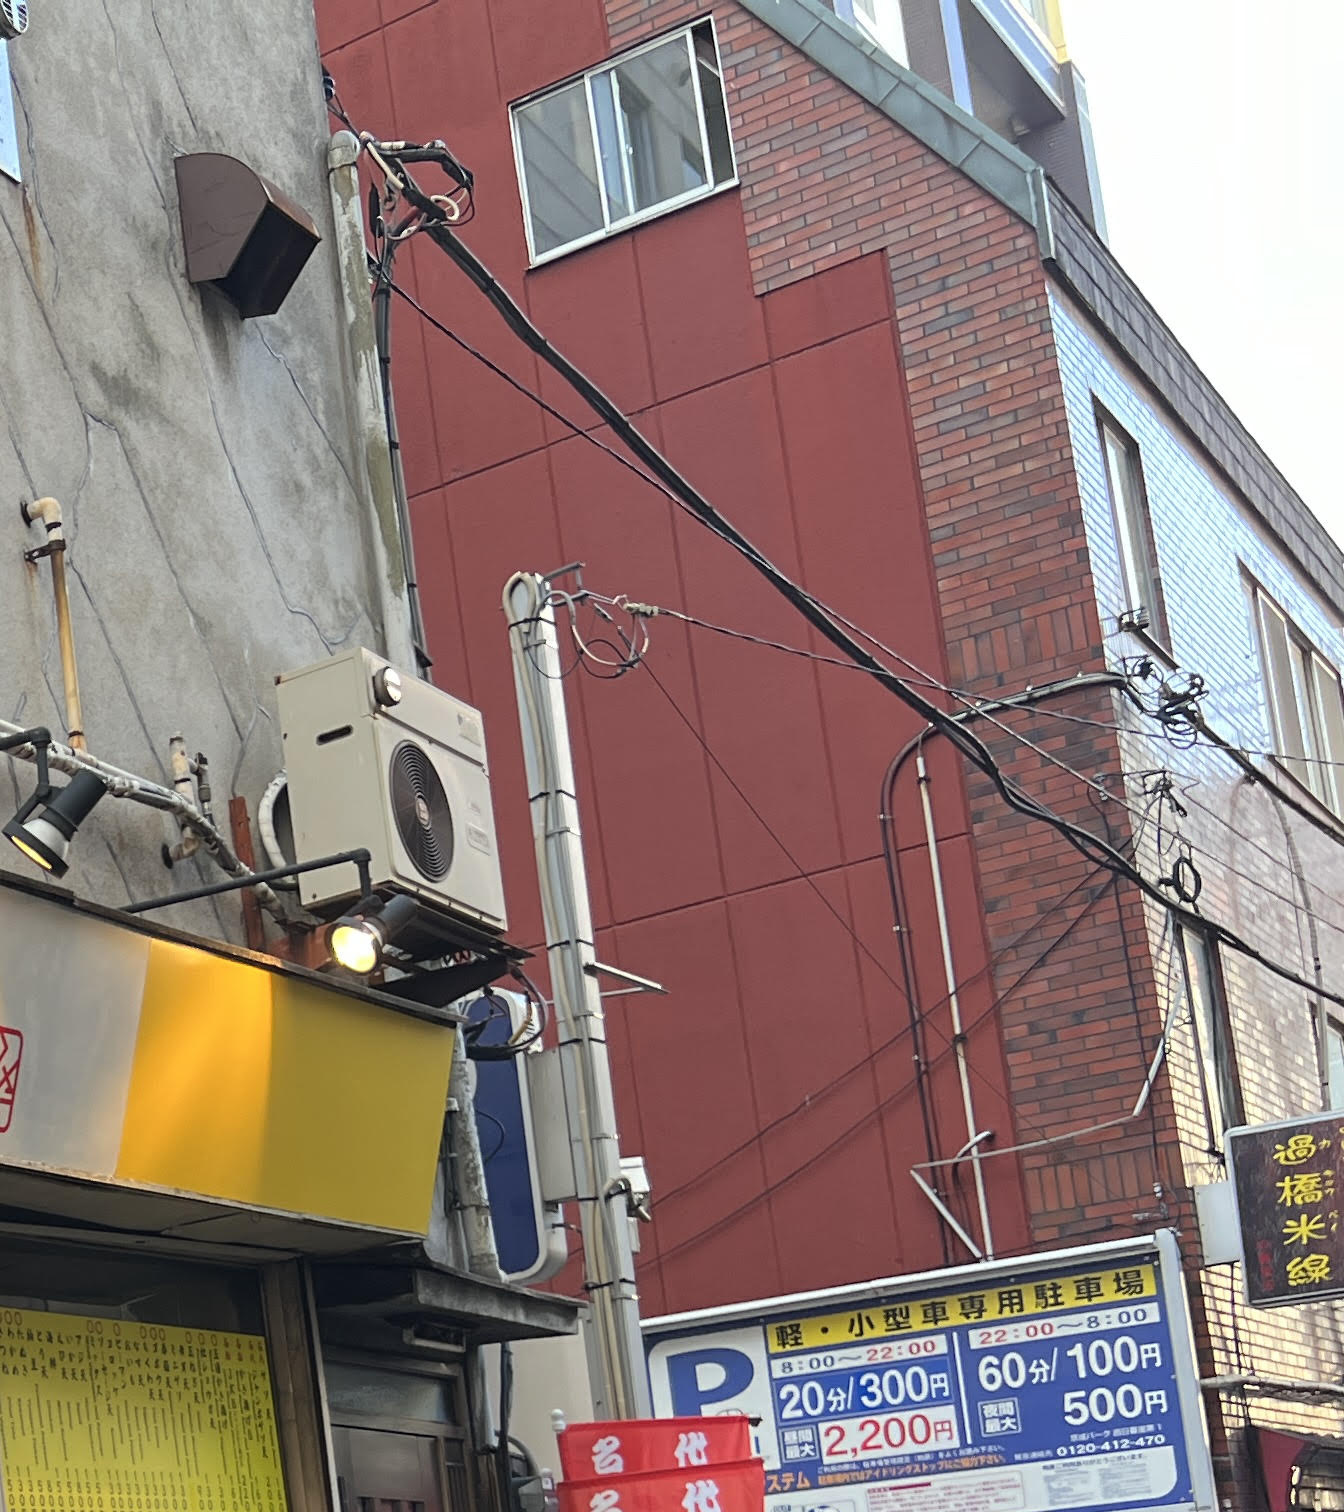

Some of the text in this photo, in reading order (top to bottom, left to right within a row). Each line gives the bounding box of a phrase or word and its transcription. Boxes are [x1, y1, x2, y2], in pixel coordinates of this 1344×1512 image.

[1273, 1134, 1333, 1286] 過橋米線
[775, 1269, 1144, 1349] 軽・小型車専用駐車場
[666, 1347, 754, 1417] P
[1064, 1383, 1168, 1426] 500円
[824, 1414, 954, 1458] 2,200円
[985, 1416, 1017, 1433] 最大
[592, 1431, 709, 1476] 名代
